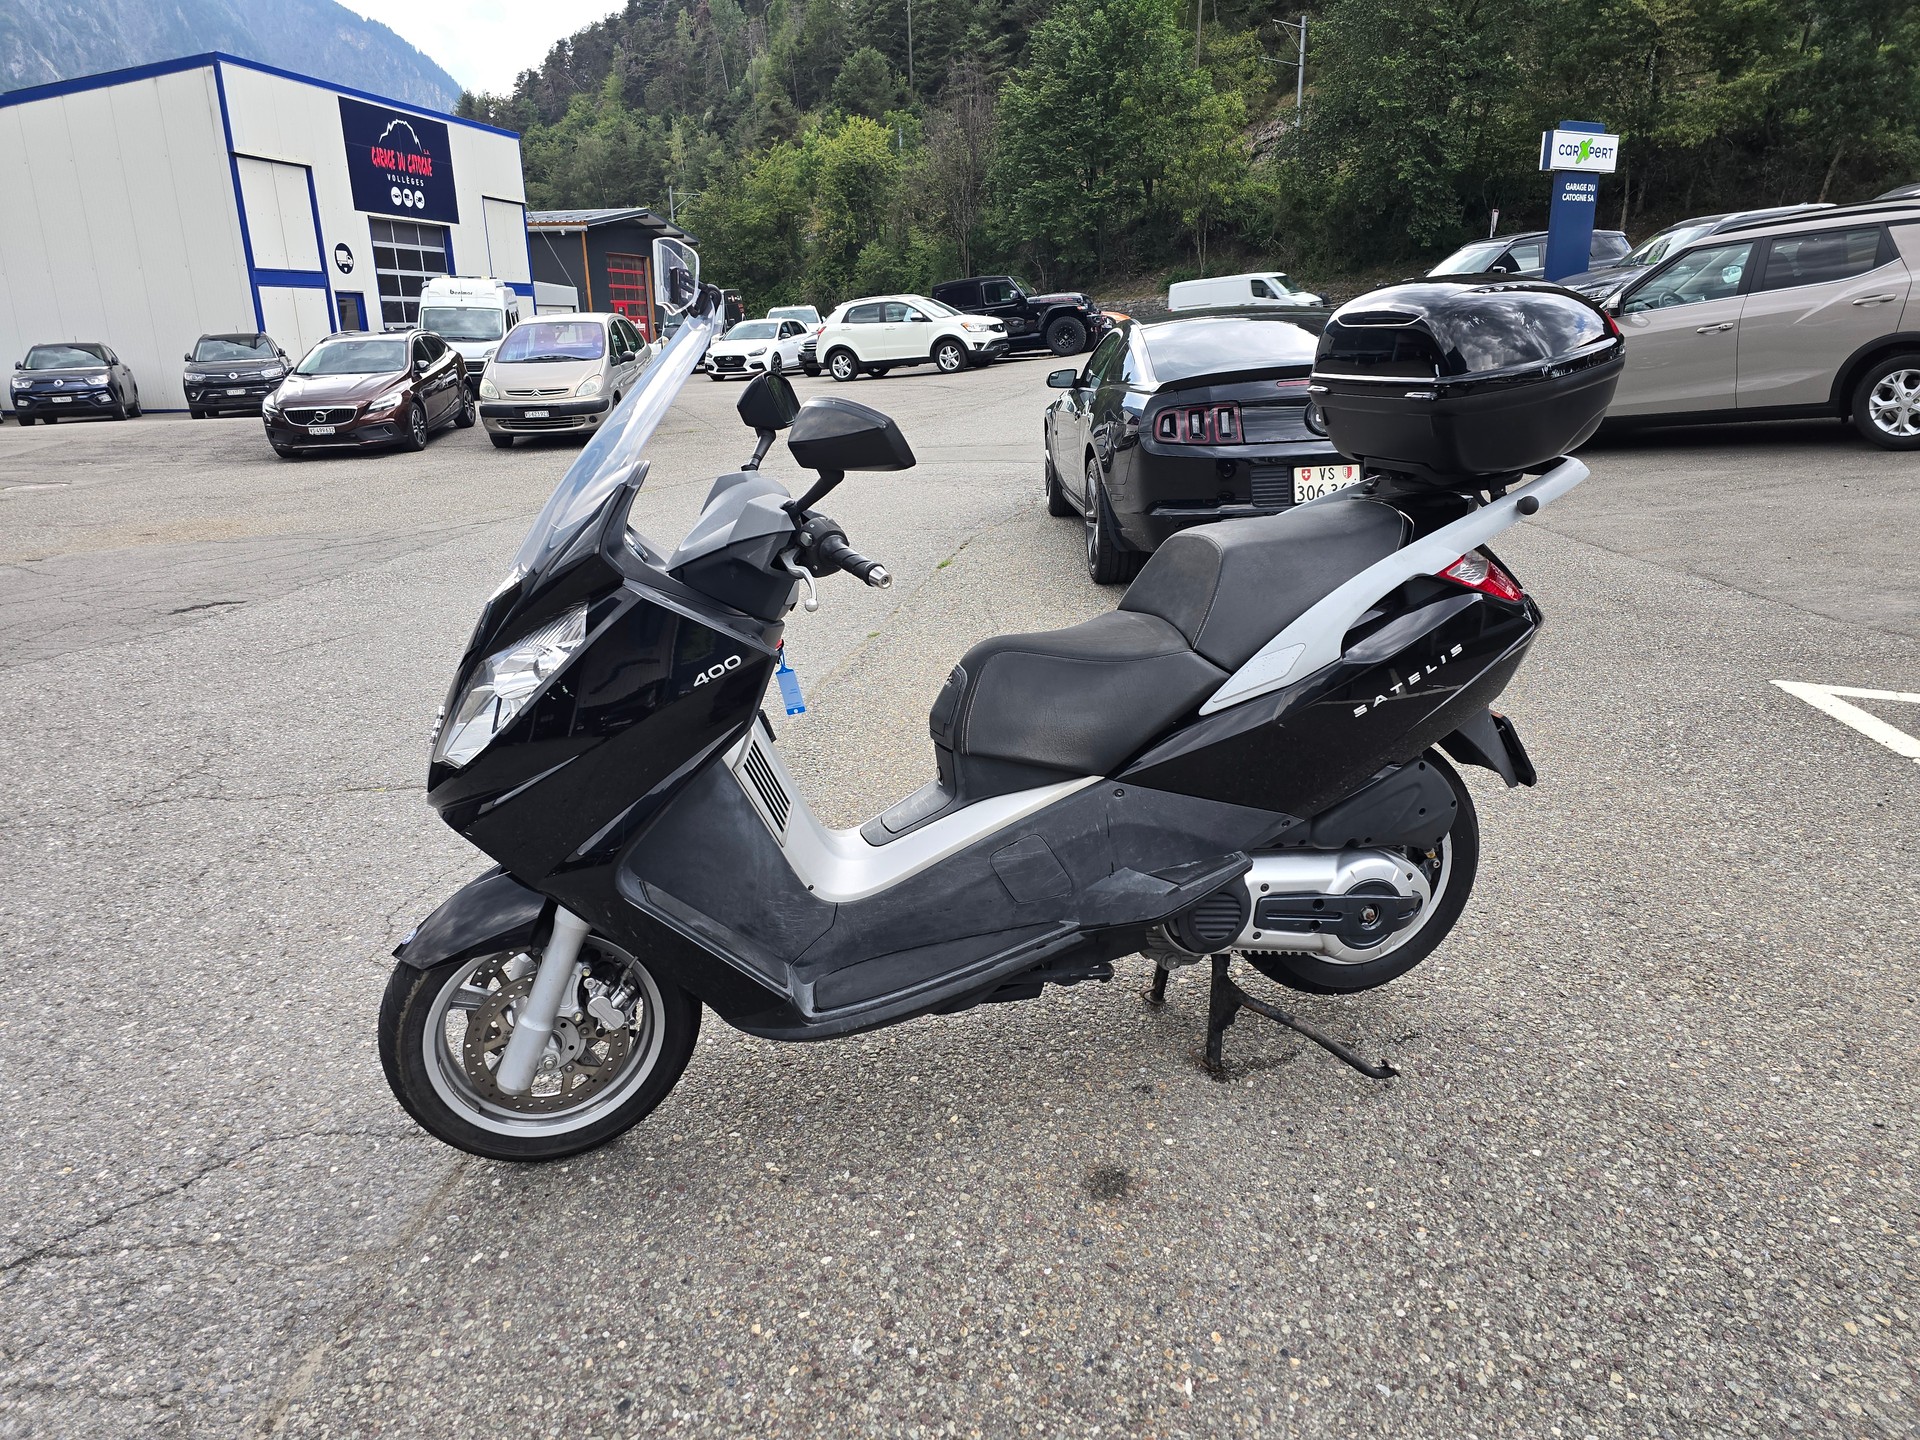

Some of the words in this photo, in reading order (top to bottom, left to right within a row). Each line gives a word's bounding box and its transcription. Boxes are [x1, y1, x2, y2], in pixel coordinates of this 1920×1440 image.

[371, 146, 396, 171] GARAGE
[396, 151, 406, 172] DU
[407, 153, 433, 177] CATOGNE
[386, 173, 424, 187] VOLLÈGES
[1565, 182, 1587, 191] GARAGE
[1587, 183, 1596, 192] DU
[1562, 193, 1587, 202] CATOGNE
[1587, 194, 1595, 202] SA
[1319, 467, 1335, 481] VS
[693, 654, 742, 687] 400
[1353, 643, 1463, 718] SATELIS
